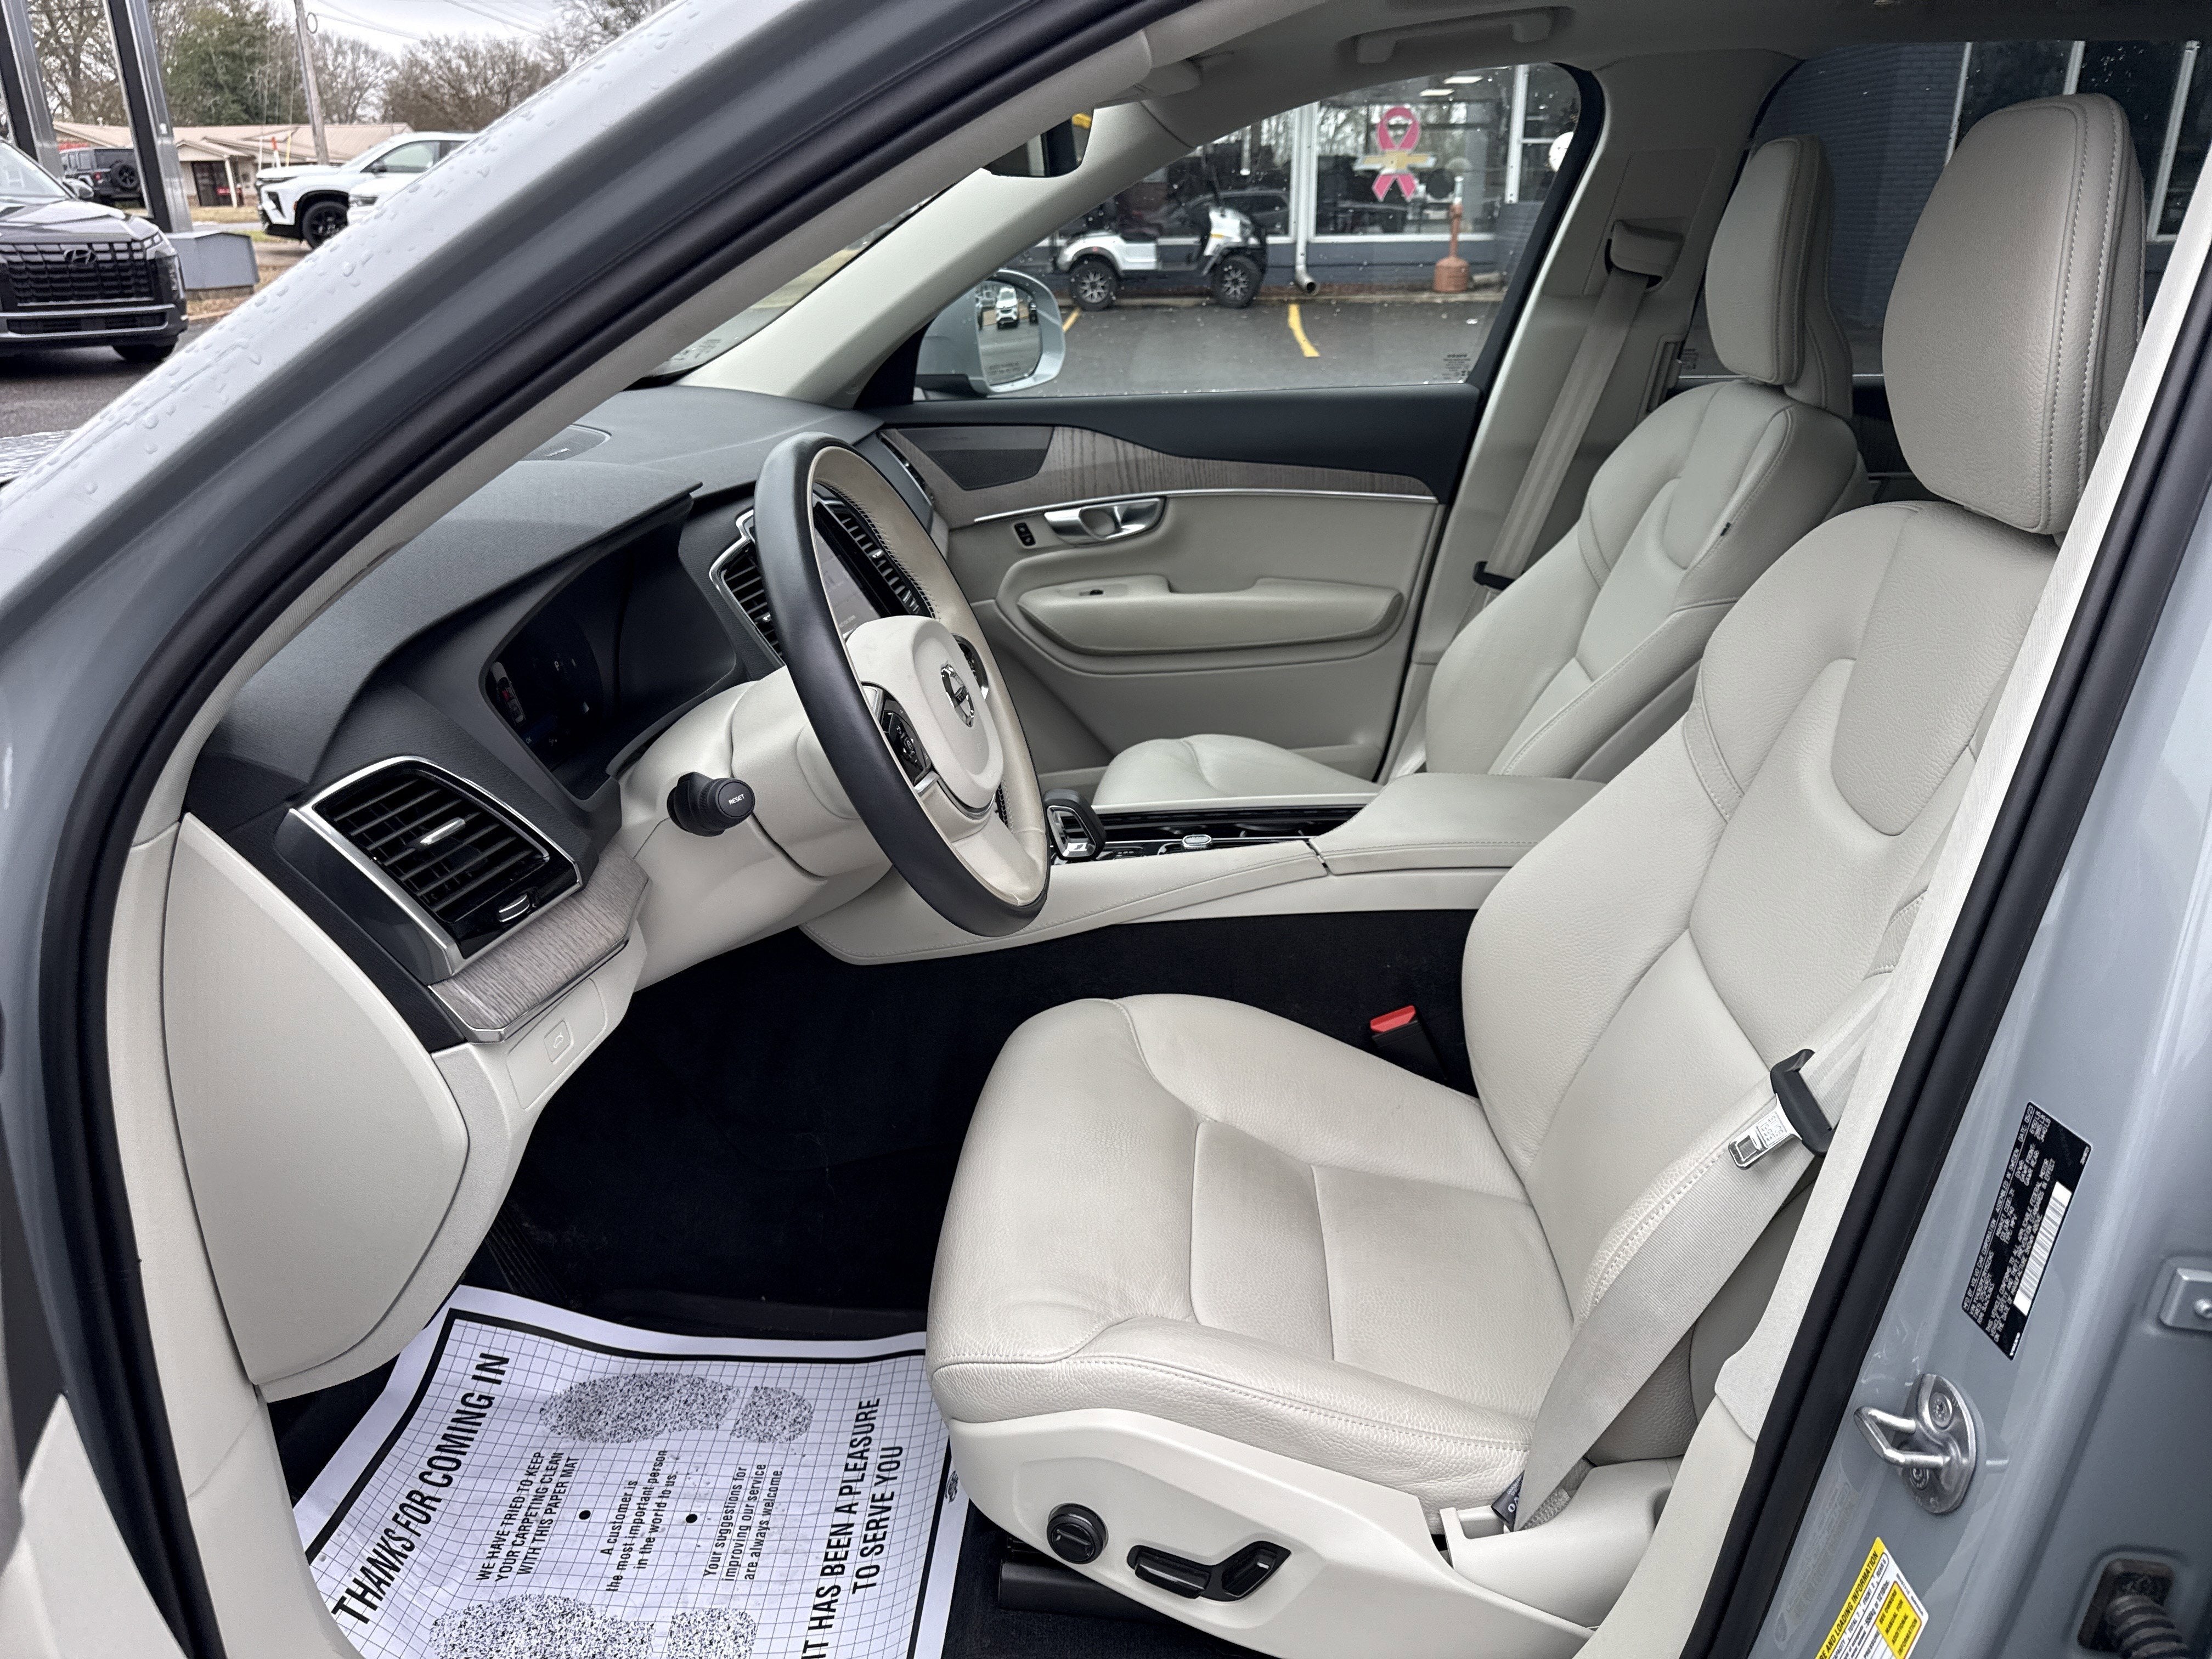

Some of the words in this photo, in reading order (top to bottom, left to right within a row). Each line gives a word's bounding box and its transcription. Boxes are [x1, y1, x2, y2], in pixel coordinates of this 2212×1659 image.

[729, 794, 744, 805] RESET
[2018, 1125, 2027, 1142] DATE:
[1996, 1181, 2008, 1212] ASSEMBLED
[2009, 1148, 2019, 1171] SWEDEN
[2019, 1164, 2028, 1182] GAWR
[2024, 1168, 2033, 1186] GAWR
[1991, 1295, 2001, 1318] VEHICLE
[1999, 1266, 2011, 1294] CONFORMS
[2009, 1256, 2015, 1265] TO
[2018, 1206, 2032, 1242] APPLICABLE
[2030, 1182, 2042, 1206] FEDERAL
[2039, 1159, 2049, 1178] MOTOR
[1996, 1213, 2006, 1237] MARKET
[1967, 1288, 1972, 1297] BY
[1971, 1268, 1979, 1286] VOLVO
[1982, 1218, 1996, 1255] CORPORATION
[1990, 1313, 2000, 1336] VEHICLE
[1999, 1291, 2008, 1313] SAFETY
[2011, 1259, 2019, 1276] THEFT
[2017, 1224, 2032, 1259] PREVENTION
[2030, 1190, 2044, 1223] STANDARDS
[2045, 1159, 2055, 1181] EFFECT
[1994, 1333, 2000, 1342] ON
[2001, 1305, 2010, 1321] DATE
[2007, 1295, 2012, 1304] OF
[2011, 1256, 2027, 1295] MANUFACTURE
[2024, 1234, 2034, 1255] SHOWN
[838, 1397, 881, 1499] PLEASURE
[524, 1452, 545, 1478] KEEP
[647, 1451, 668, 1483] person
[665, 1471, 678, 1486] us.
[874, 1445, 904, 1487] YOU
[332, 1528, 415, 1624] THANKS
[392, 1489, 443, 1538] FOR
[419, 1392, 495, 1487] COMING
[471, 1352, 510, 1385] IN
[516, 1479, 533, 1493] TO
[658, 1490, 672, 1498] to
[748, 1464, 766, 1501] service
[761, 1466, 784, 1516] welcome.
[494, 1549, 519, 1582] YOUR
[511, 1486, 546, 1547] CARPETING
[540, 1452, 565, 1484] CLEAN
[500, 1496, 525, 1527] TRIED
[516, 1546, 542, 1576] WITH
[532, 1518, 554, 1544] THIS
[544, 1482, 569, 1516] PAPER
[560, 1457, 580, 1478] MAT
[600, 1547, 614, 1555] A
[607, 1492, 633, 1544] customer
[624, 1481, 638, 1489] is
[625, 1487, 654, 1538] important
[648, 1503, 667, 1533] world
[703, 1551, 722, 1577] Your
[715, 1484, 743, 1549] suggestions
[733, 1466, 747, 1481] for
[742, 1503, 755, 1521] our
[834, 1502, 859, 1515] A
[749, 1520, 770, 1558] always
[860, 1493, 895, 1558] SERVE
[488, 1530, 510, 1559] HAVE
[617, 1543, 635, 1570] most
[639, 1537, 655, 1554] the
[721, 1525, 752, 1581] improving
[820, 1522, 854, 1578] BEEN
[476, 1562, 496, 1581] WE
[633, 1559, 648, 1569] in
[744, 1561, 758, 1581] are
[852, 1564, 881, 1595] TO
[606, 1575, 623, 1592] the
[1863, 1587, 1872, 1605] FRONT
[808, 1584, 841, 1630] HAS
[1826, 1635, 1836, 1654] AND
[1835, 1602, 1854, 1637] LOADING
[1852, 1550, 1878, 1602] INFORMATION
[1885, 1612, 1899, 1635] MANUAL
[1892, 1613, 1909, 1646] ADDITIONAL
[1898, 1617, 1918, 1656] INFORMATION
[802, 1640, 829, 1659] IT
[1833, 1639, 1845, 1659] APACITY
[1864, 1629, 1880, 1658] PRESSURE
